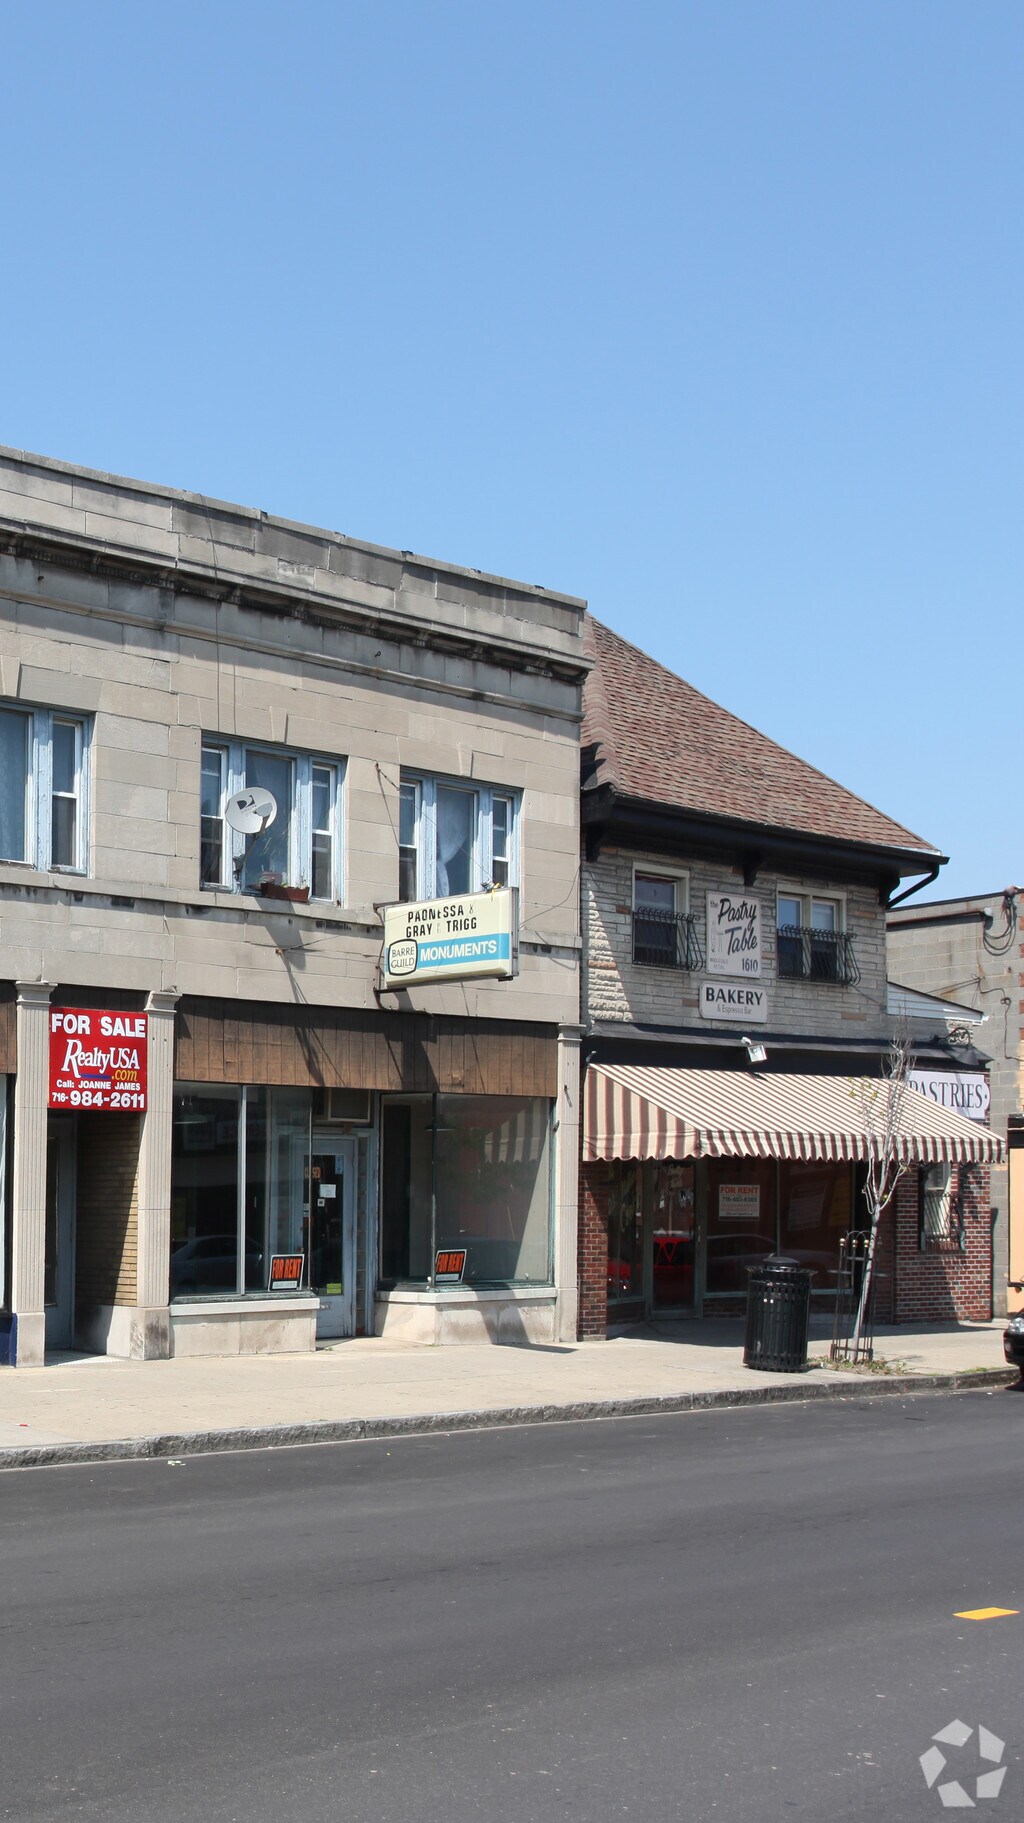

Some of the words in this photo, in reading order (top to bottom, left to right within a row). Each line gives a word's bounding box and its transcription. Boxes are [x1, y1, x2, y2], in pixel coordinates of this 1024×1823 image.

[718, 898, 756, 930] Pastry
[406, 923, 433, 938] GRAY
[446, 917, 477, 933] TRIGG
[725, 926, 757, 956] Table
[392, 946, 414, 958] BARRE
[420, 940, 497, 962] MONUMENTS
[391, 957, 414, 969] GUILD
[742, 959, 758, 972] 1610
[706, 987, 763, 1005] BAKERY
[722, 1005, 743, 1015] Espresso
[51, 1013, 90, 1034] FOR
[100, 1016, 145, 1037] SALE
[61, 1039, 140, 1078] RealtyUSA
[56, 1079, 74, 1088] Call:
[78, 1081, 111, 1089] JOANNE
[111, 1069, 137, 1082] .com
[720, 1186, 736, 1194] FOR
[737, 1186, 759, 1194] RENT
[272, 1258, 285, 1279] FOR
[284, 1258, 301, 1279] RENT
[435, 1252, 449, 1273] FOR
[447, 1252, 464, 1272] RENT
